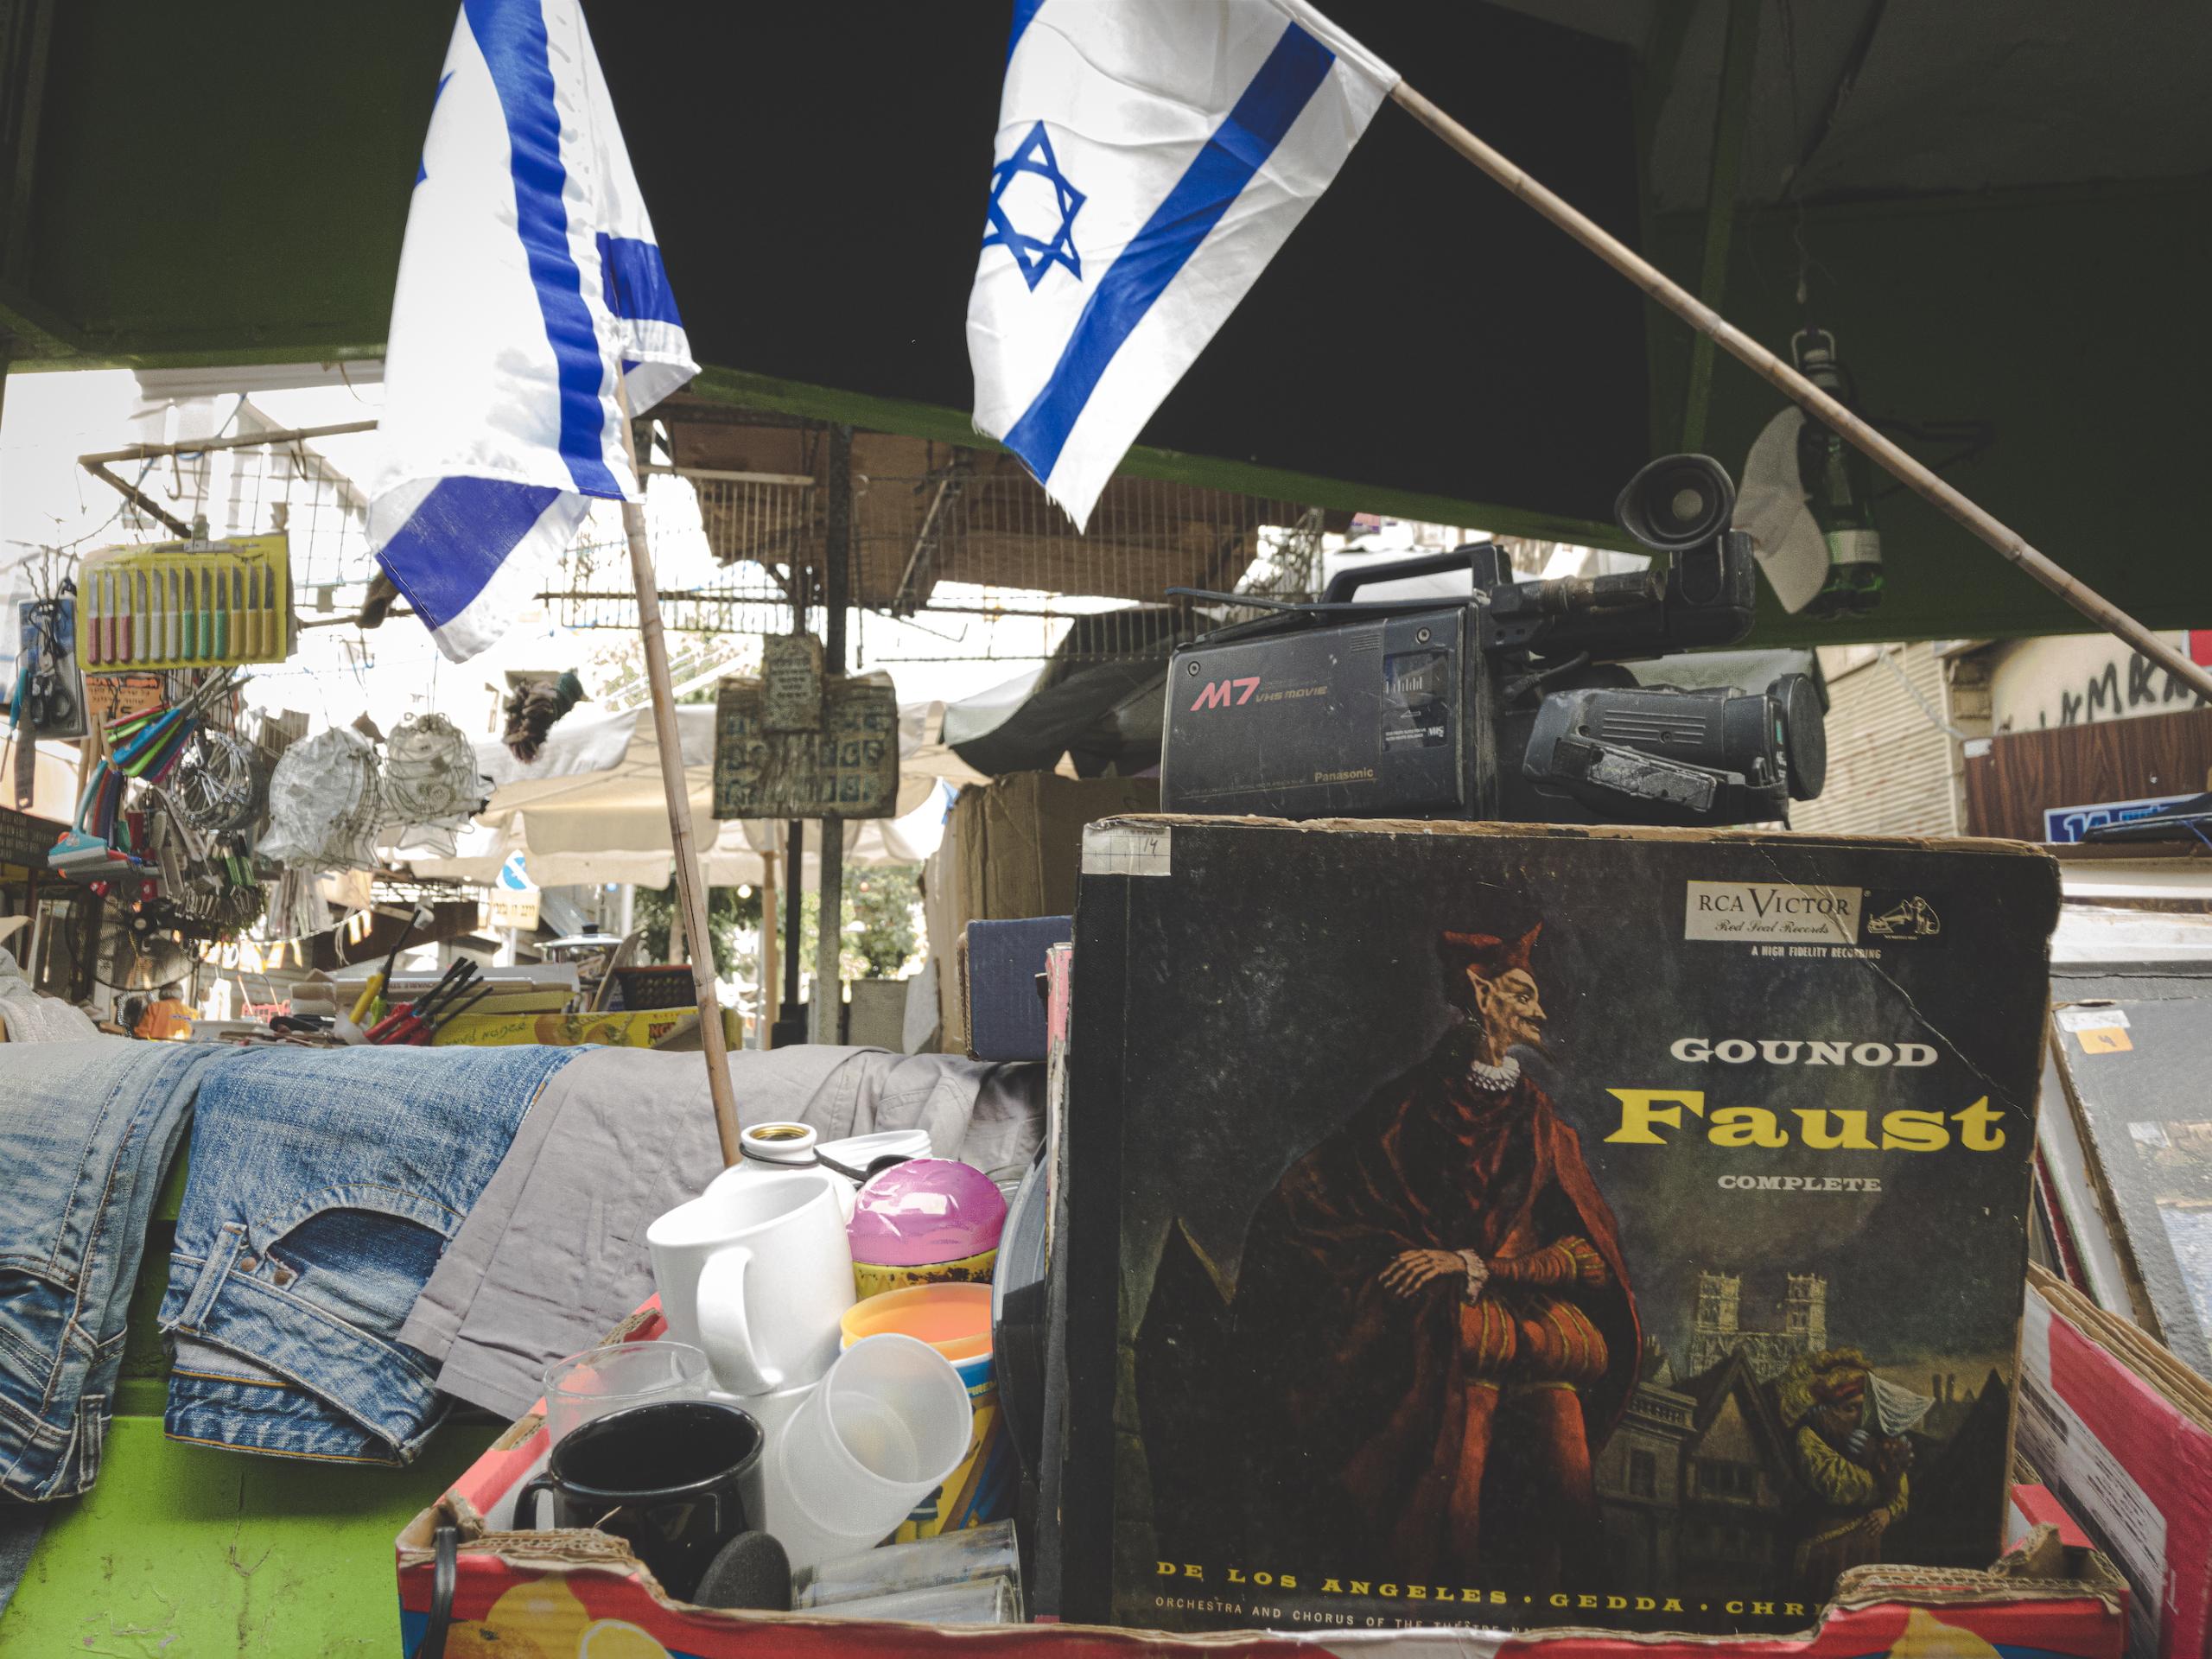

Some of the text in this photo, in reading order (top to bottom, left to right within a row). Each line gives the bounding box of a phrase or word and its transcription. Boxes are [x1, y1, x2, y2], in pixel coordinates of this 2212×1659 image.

[1189, 676, 1261, 712] M7
[1255, 693, 1283, 702] VHS
[1285, 686, 1328, 699] MOVIE
[1314, 767, 1375, 783] Panasonic
[1699, 894, 1745, 912] RCA
[1714, 918, 1744, 932] Red
[1780, 920, 1830, 934] Records
[1751, 946, 1758, 956] A
[1761, 946, 1785, 957] HIGH
[1789, 947, 1827, 958] FIDELITY
[1670, 1037, 1938, 1067] GOUNOD
[1603, 1088, 2006, 1152] Faust
[1717, 1174, 1882, 1192] COMPLETE
[1156, 1561, 1204, 1579] DE
[1227, 1568, 1298, 1589] LOS
[1321, 1578, 1507, 1605] ANGELES
[1549, 1593, 1684, 1612] GEDDA
[1155, 1597, 1243, 1615] ORCHESTRA
[1252, 1607, 1281, 1618] AND
[1293, 1610, 1355, 1625] CHORUS
[1366, 1616, 1384, 1628] OF
